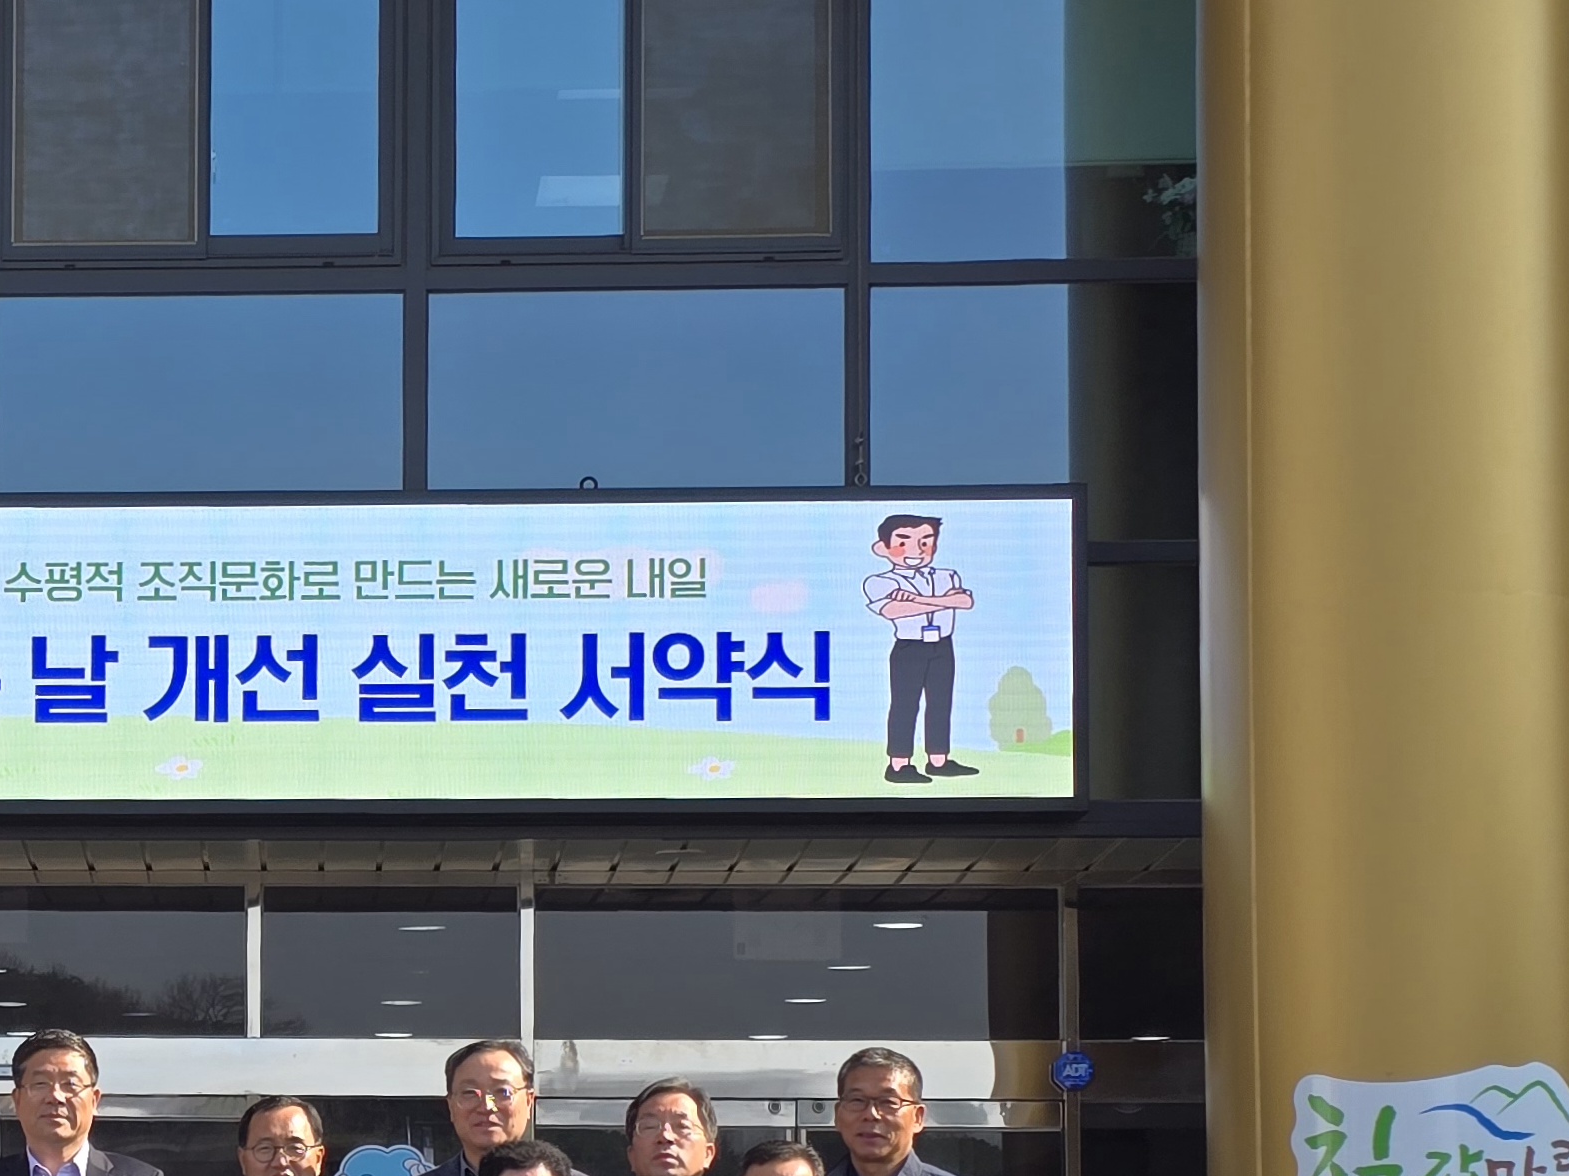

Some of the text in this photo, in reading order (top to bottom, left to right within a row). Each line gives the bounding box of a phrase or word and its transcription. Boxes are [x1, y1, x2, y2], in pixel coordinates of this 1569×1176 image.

[4, 562, 124, 603] 수평적
[137, 561, 342, 602] 조직문화로
[355, 560, 477, 600] 만드는
[490, 559, 613, 600] 새로운
[627, 558, 708, 599] 내일
[32, 633, 119, 723] 날
[144, 632, 320, 722] 개선
[352, 632, 528, 722] 실천
[560, 630, 831, 721] 서약식
[1063, 1064, 1088, 1077] ADT
